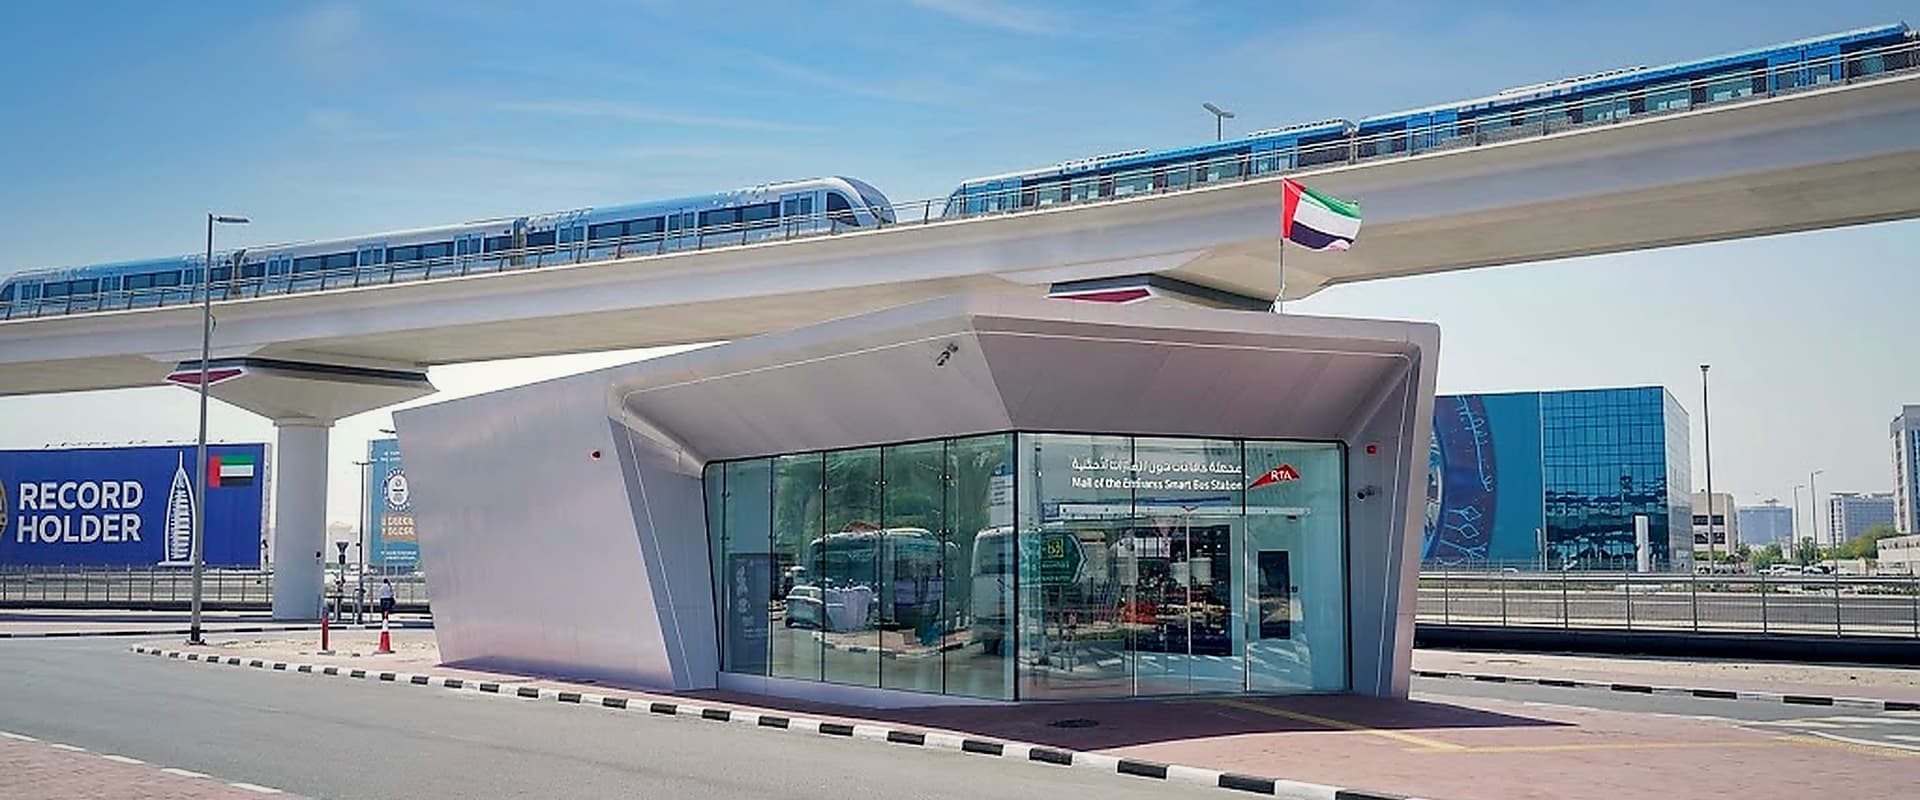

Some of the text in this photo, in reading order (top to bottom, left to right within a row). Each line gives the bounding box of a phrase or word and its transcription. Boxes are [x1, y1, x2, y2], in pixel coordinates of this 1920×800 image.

[1071, 476, 1093, 488] Mall
[1105, 477, 1122, 488] the
[1165, 479, 1191, 490] Smart
[1193, 480, 1210, 490] Bus
[1211, 480, 1243, 491] Station
[1270, 470, 1292, 481] RTA
[19, 481, 144, 510] RECORD
[17, 513, 142, 544] HOLDER
